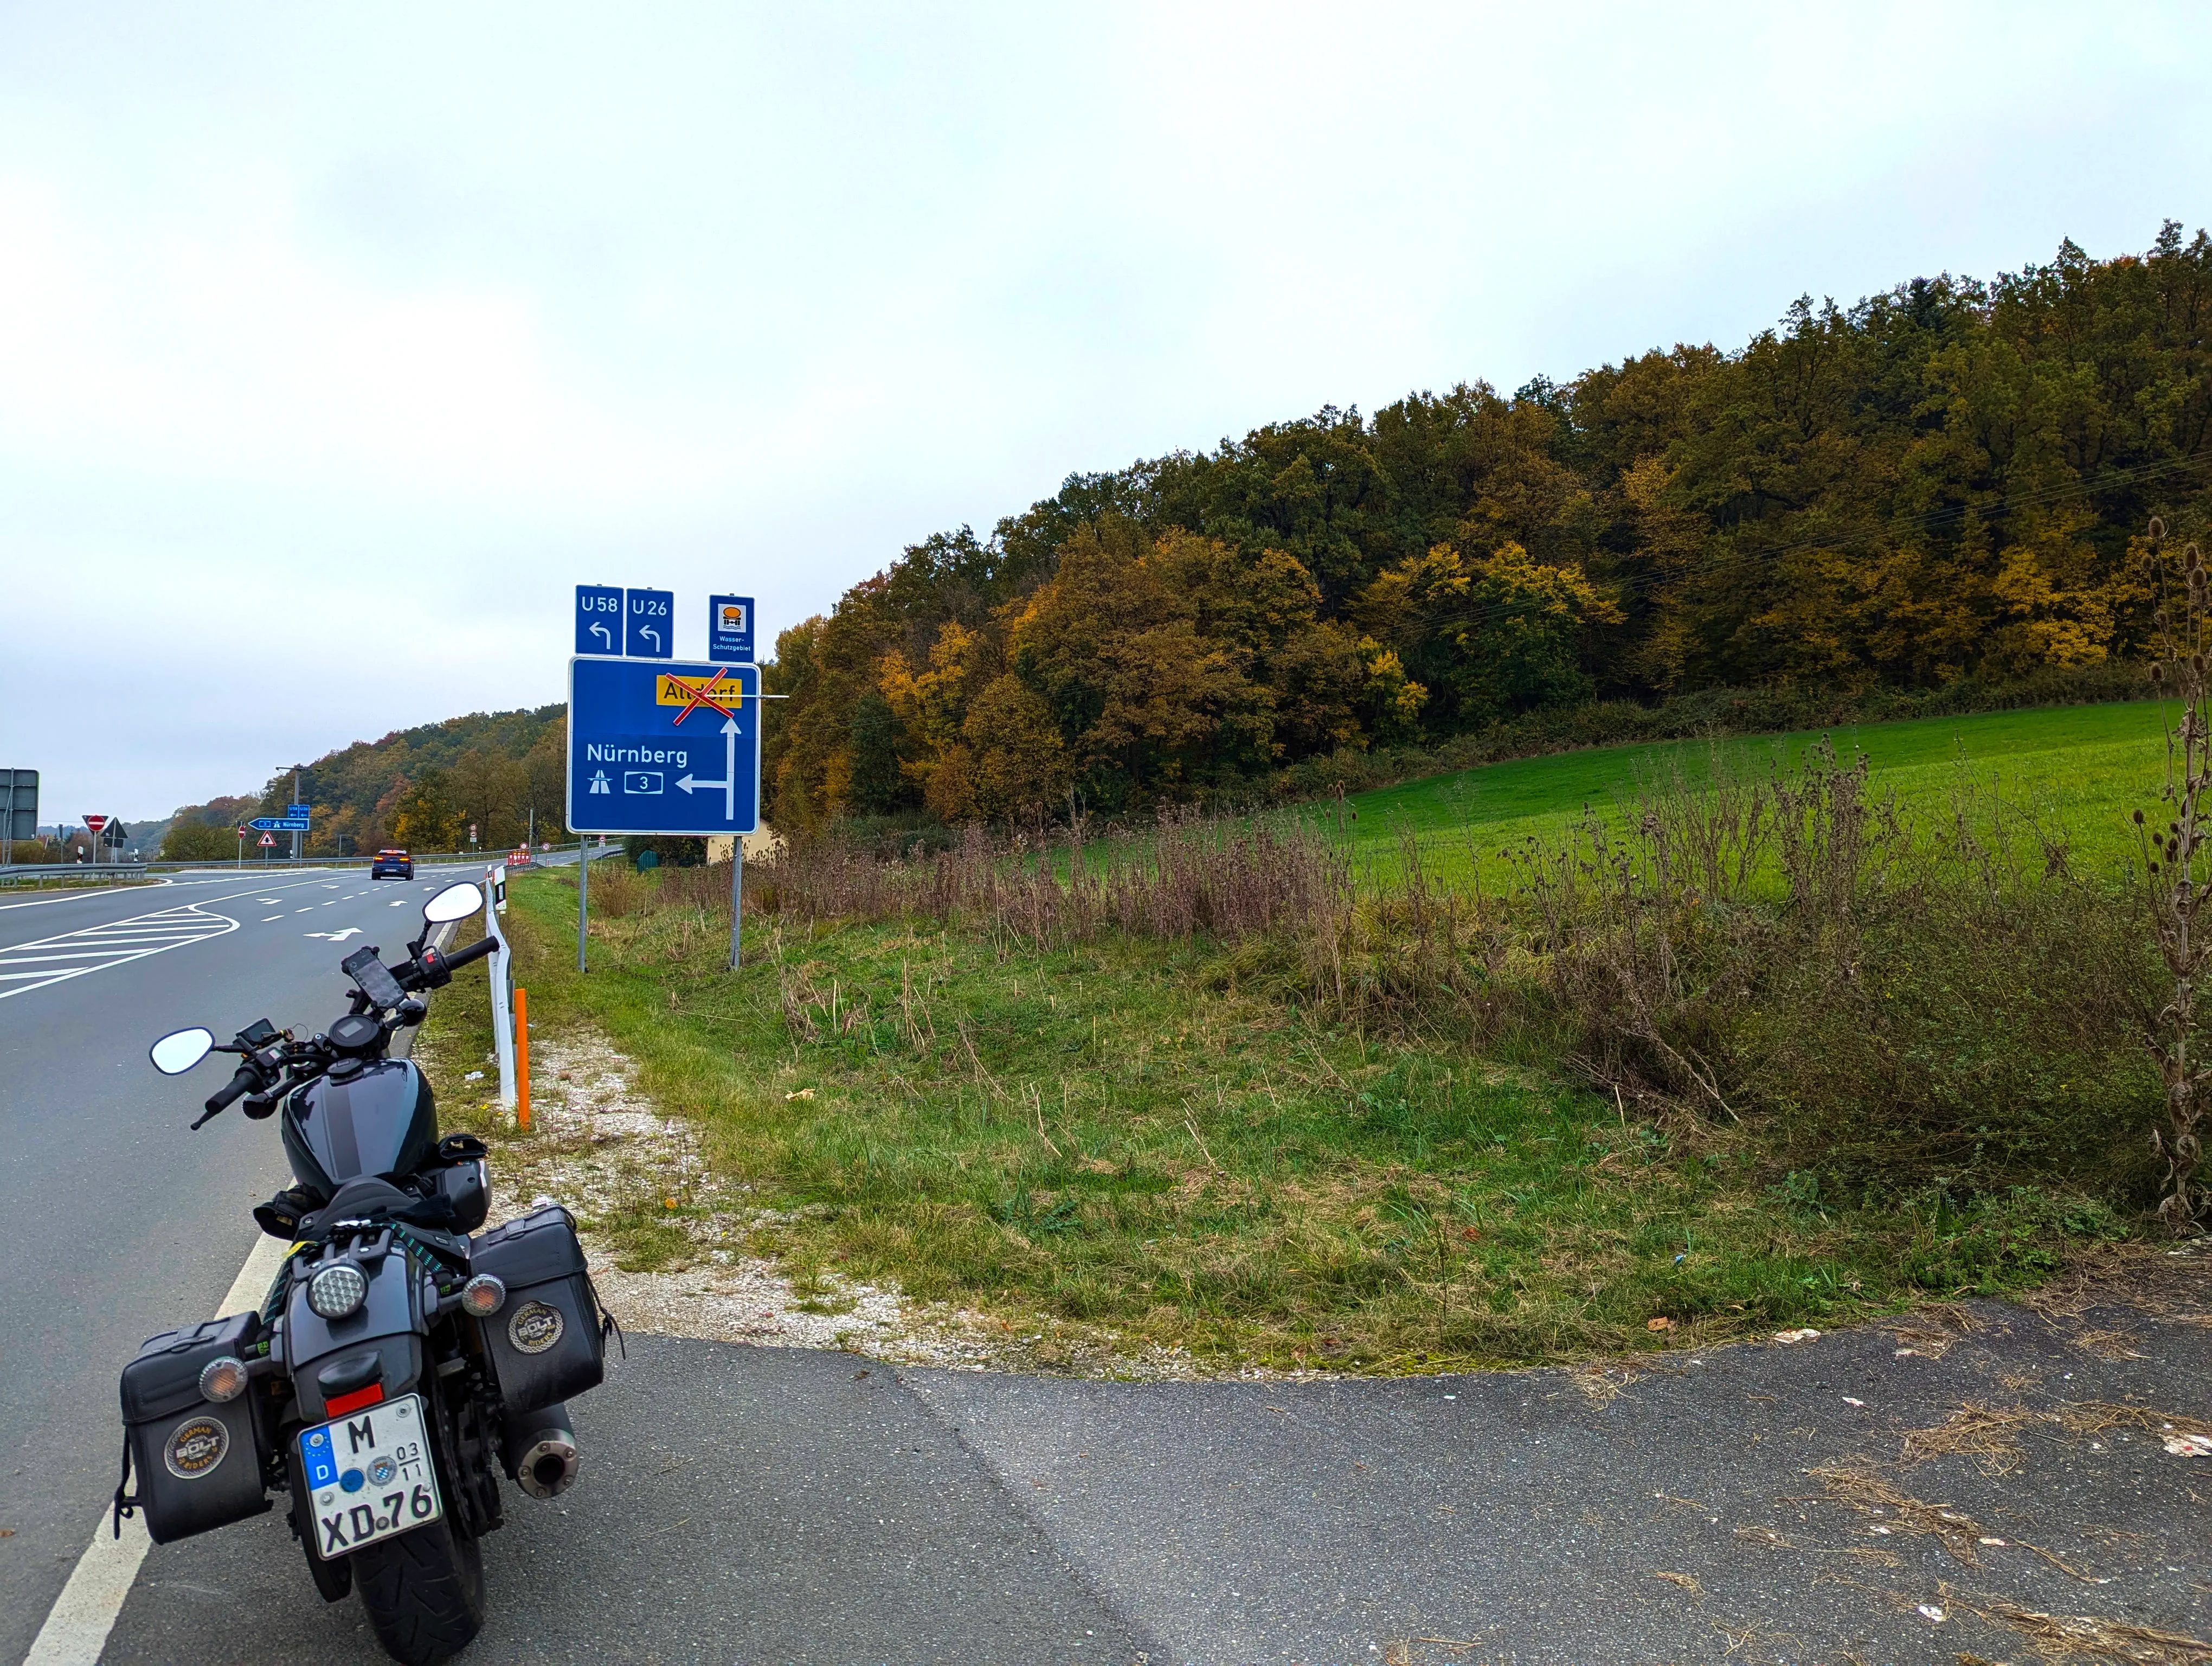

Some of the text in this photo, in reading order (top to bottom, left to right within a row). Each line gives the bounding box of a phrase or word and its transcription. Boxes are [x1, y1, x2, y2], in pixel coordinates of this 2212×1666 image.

[587, 744, 687, 768] Nürnberg
[639, 776, 648, 790] 3
[517, 1316, 553, 1337] BOLT
[348, 1415, 375, 1454] M
[176, 1436, 219, 1458] BOLT
[396, 1442, 419, 1460] 03
[316, 1465, 329, 1481] D
[402, 1463, 422, 1481] 11
[321, 1484, 433, 1553] XD 76
